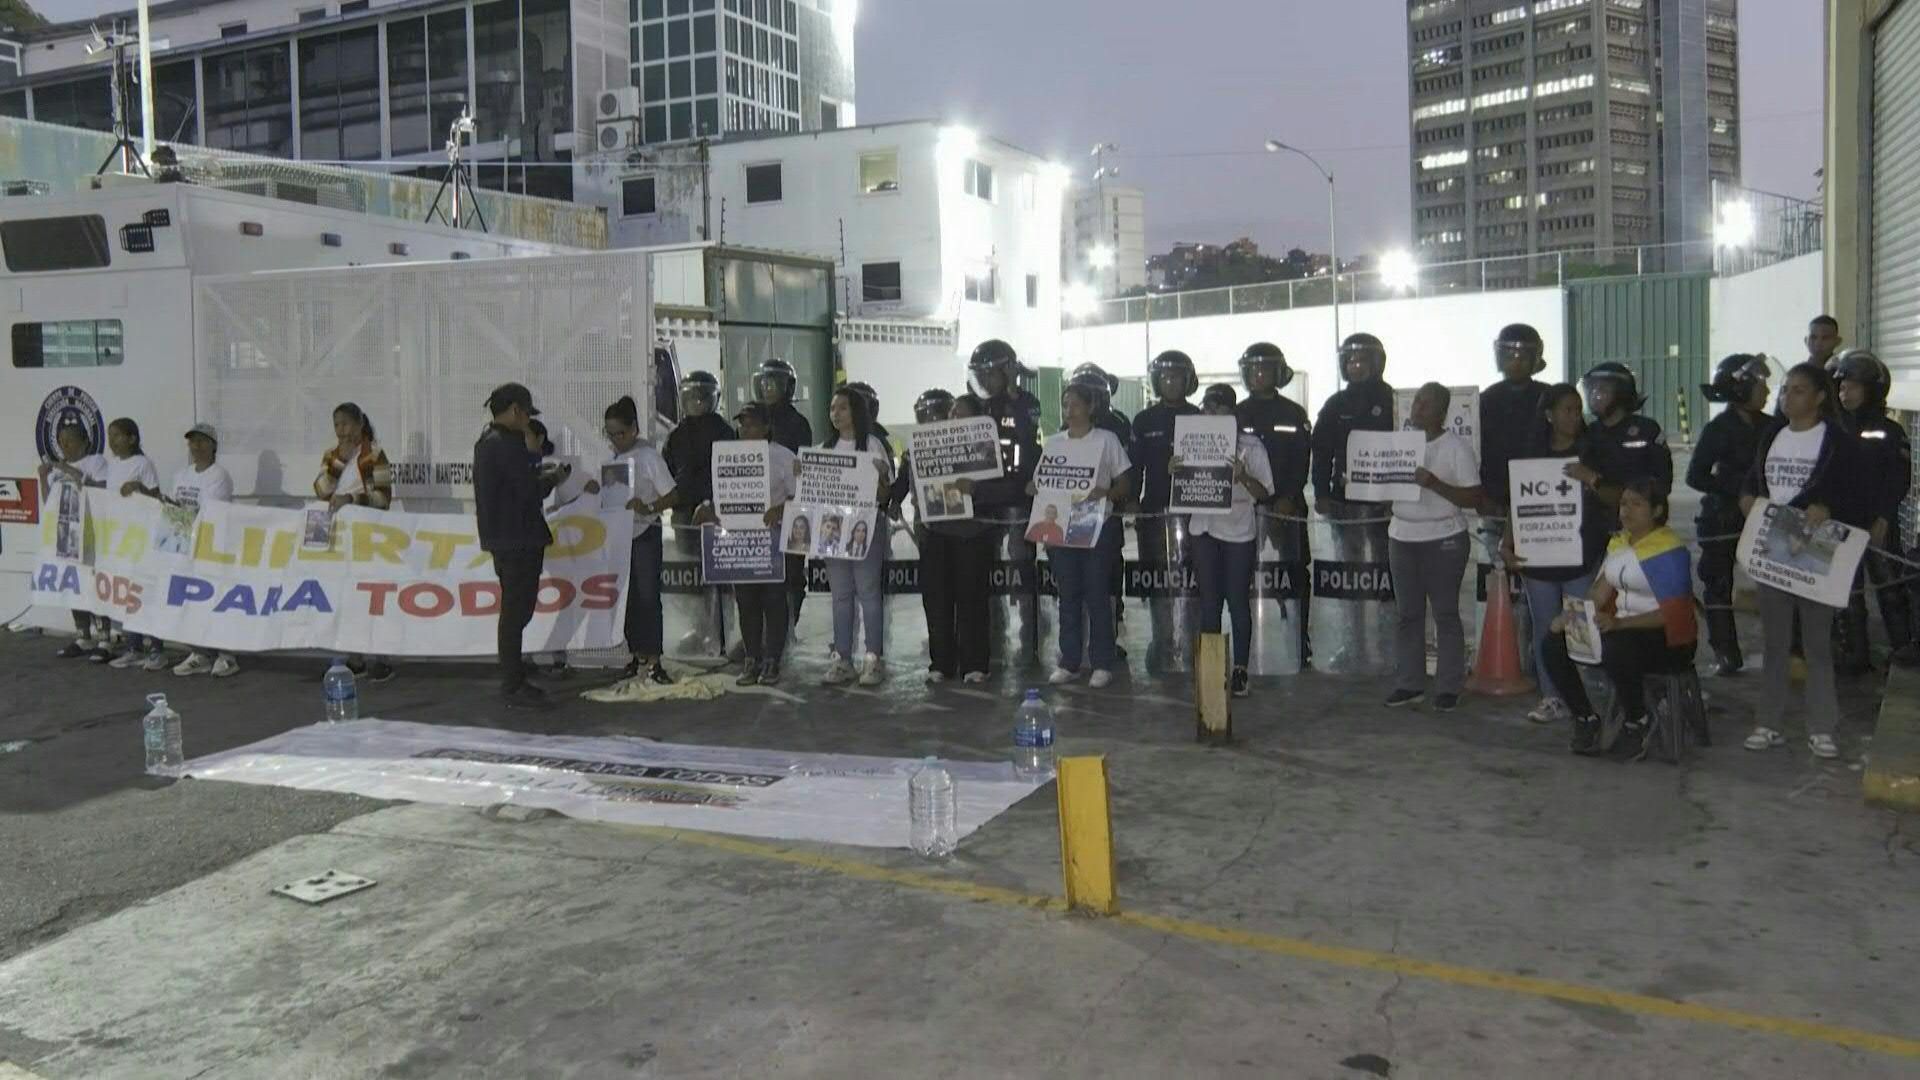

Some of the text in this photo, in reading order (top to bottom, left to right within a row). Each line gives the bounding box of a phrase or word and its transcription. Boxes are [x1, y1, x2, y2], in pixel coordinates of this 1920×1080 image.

[913, 427, 948, 439] PENSAR
[913, 440, 926, 448] NO
[1358, 448, 1370, 458] LA
[1404, 449, 1416, 457] NO
[718, 453, 763, 464] PRESOS
[802, 455, 817, 463] LAS
[1041, 455, 1067, 465] NO
[436, 463, 472, 484] MANIFESTAC
[813, 466, 842, 475] PRESOS
[928, 466, 940, 475] LO
[1040, 467, 1091, 476] TENEMOS
[1194, 470, 1212, 480] MÁS
[718, 481, 763, 490] NI OLVIDO
[821, 483, 859, 492] CUSTODIA
[1037, 478, 1090, 490] MIEDO
[816, 489, 846, 498] ESTADO
[712, 547, 771, 557] CAUTIVOS
[888, 567, 919, 586] POLI
[1132, 566, 1197, 589] POLICÍA
[1320, 568, 1391, 591] POLICÍA
